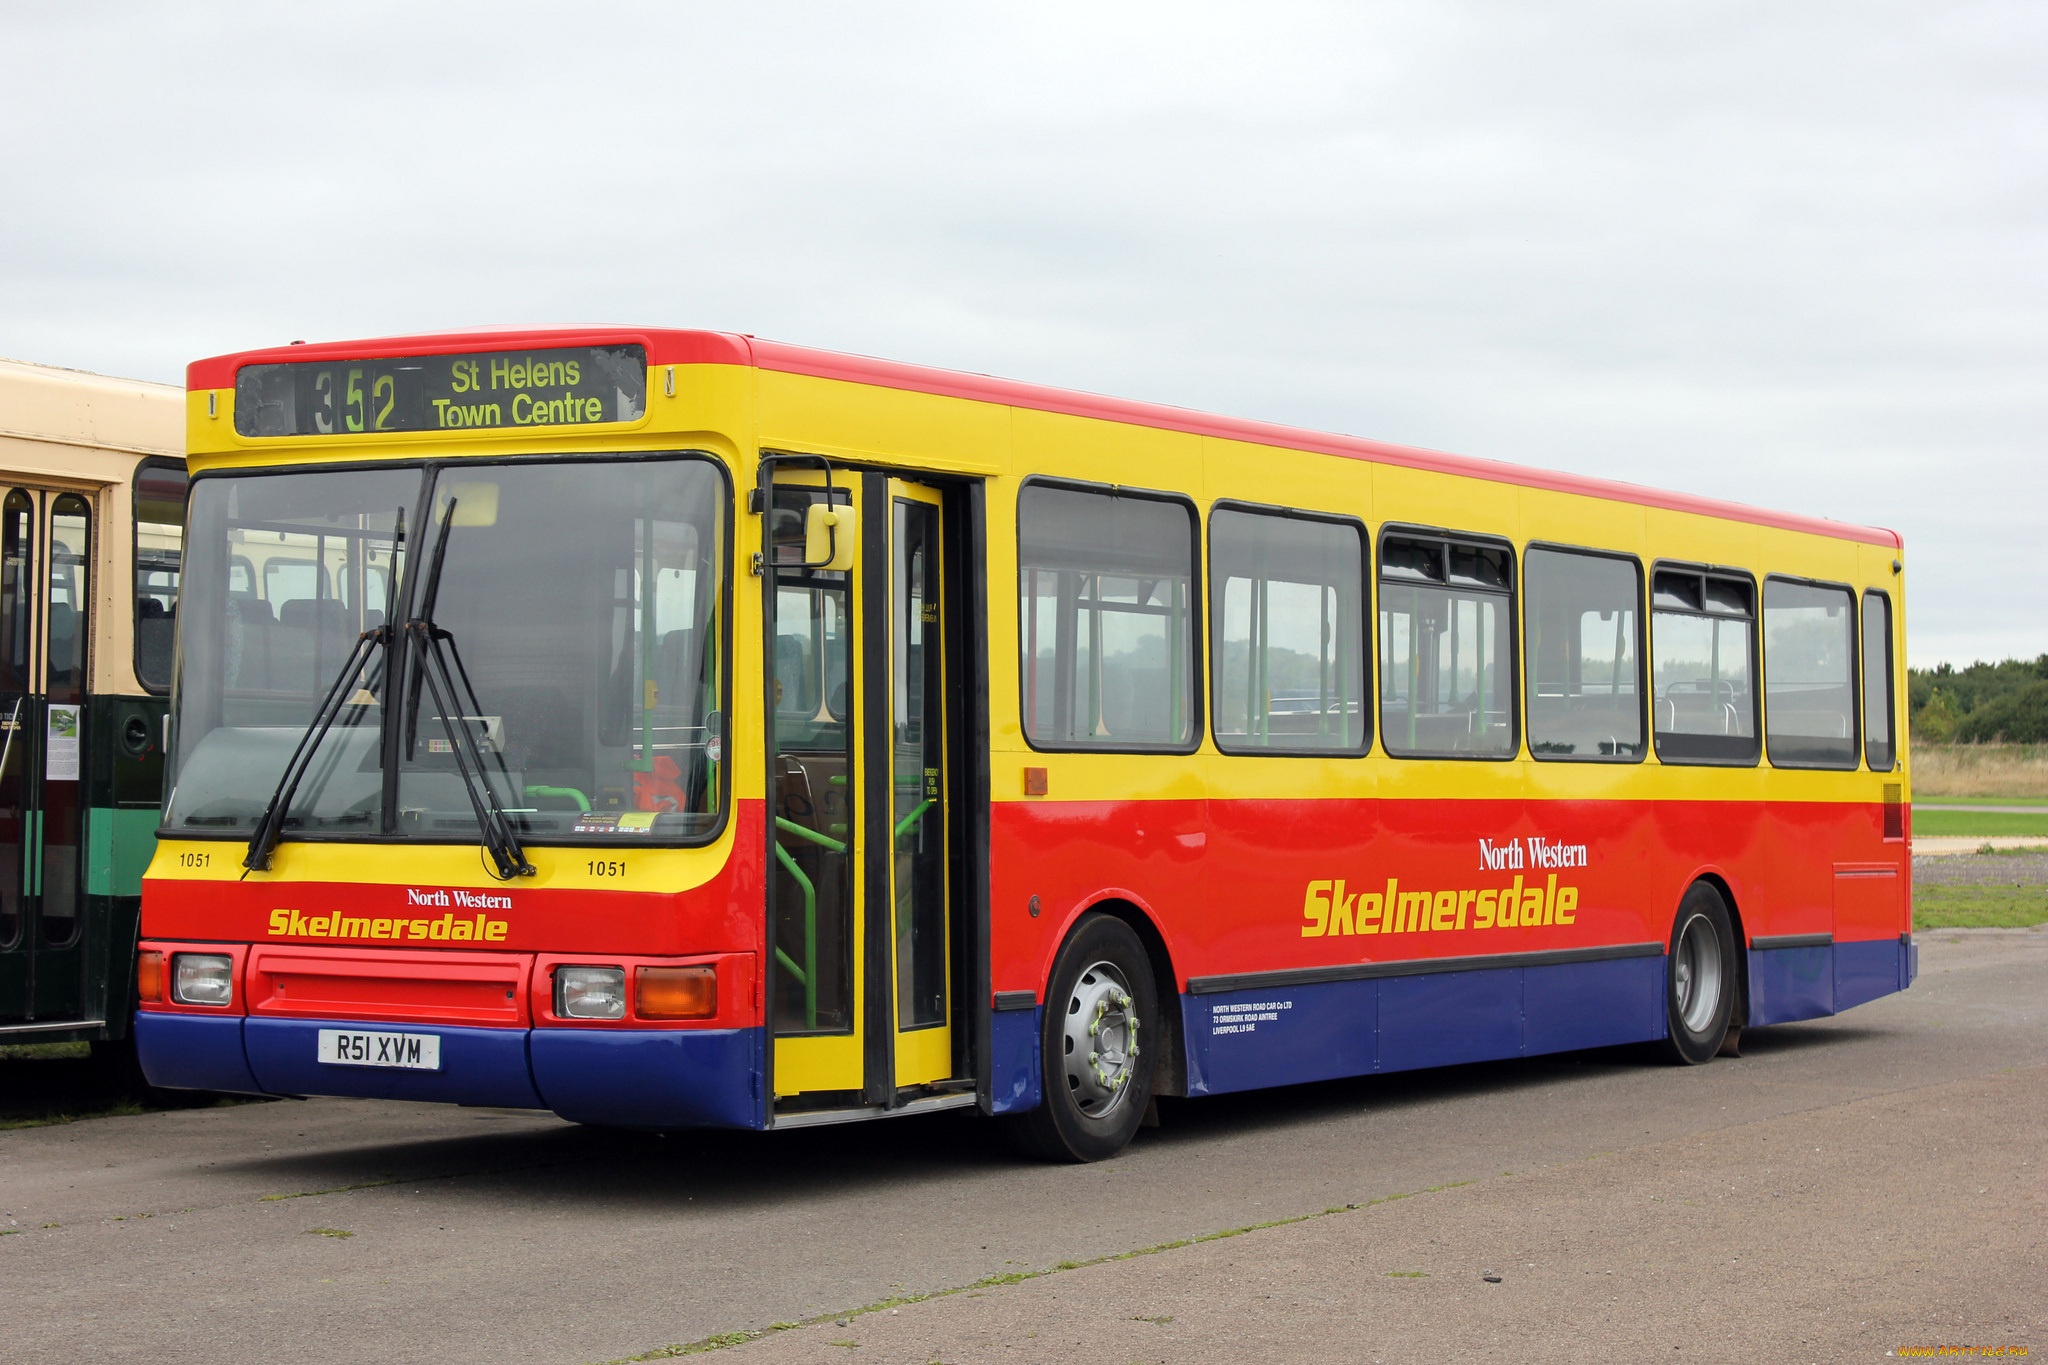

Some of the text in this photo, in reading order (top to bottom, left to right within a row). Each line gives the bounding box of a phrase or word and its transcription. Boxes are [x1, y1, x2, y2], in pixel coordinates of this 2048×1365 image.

[452, 357, 581, 393] St Helens
[315, 369, 395, 434] 352
[432, 392, 602, 428] Town Centre
[179, 852, 211, 868] 1051
[1479, 837, 1588, 870] North Western
[587, 860, 627, 877] 1051
[407, 888, 512, 909] North Western
[1301, 873, 1579, 937] Skelmersdale
[268, 908, 508, 941] Skelmersdale
[1213, 1005, 1229, 1014] NORTH
[1230, 1003, 1252, 1013] WESTERN
[1253, 1002, 1266, 1011] ROAD
[1266, 1002, 1277, 1010] CAR
[1283, 1001, 1292, 1009] LTD
[1219, 1014, 1244, 1023] ORMSKIRK
[1244, 1013, 1258, 1022] ROAD
[1258, 1012, 1277, 1021] AINTREE
[1213, 1025, 1239, 1035] LIVERPOOL
[337, 1035, 421, 1064] R51 XVM
